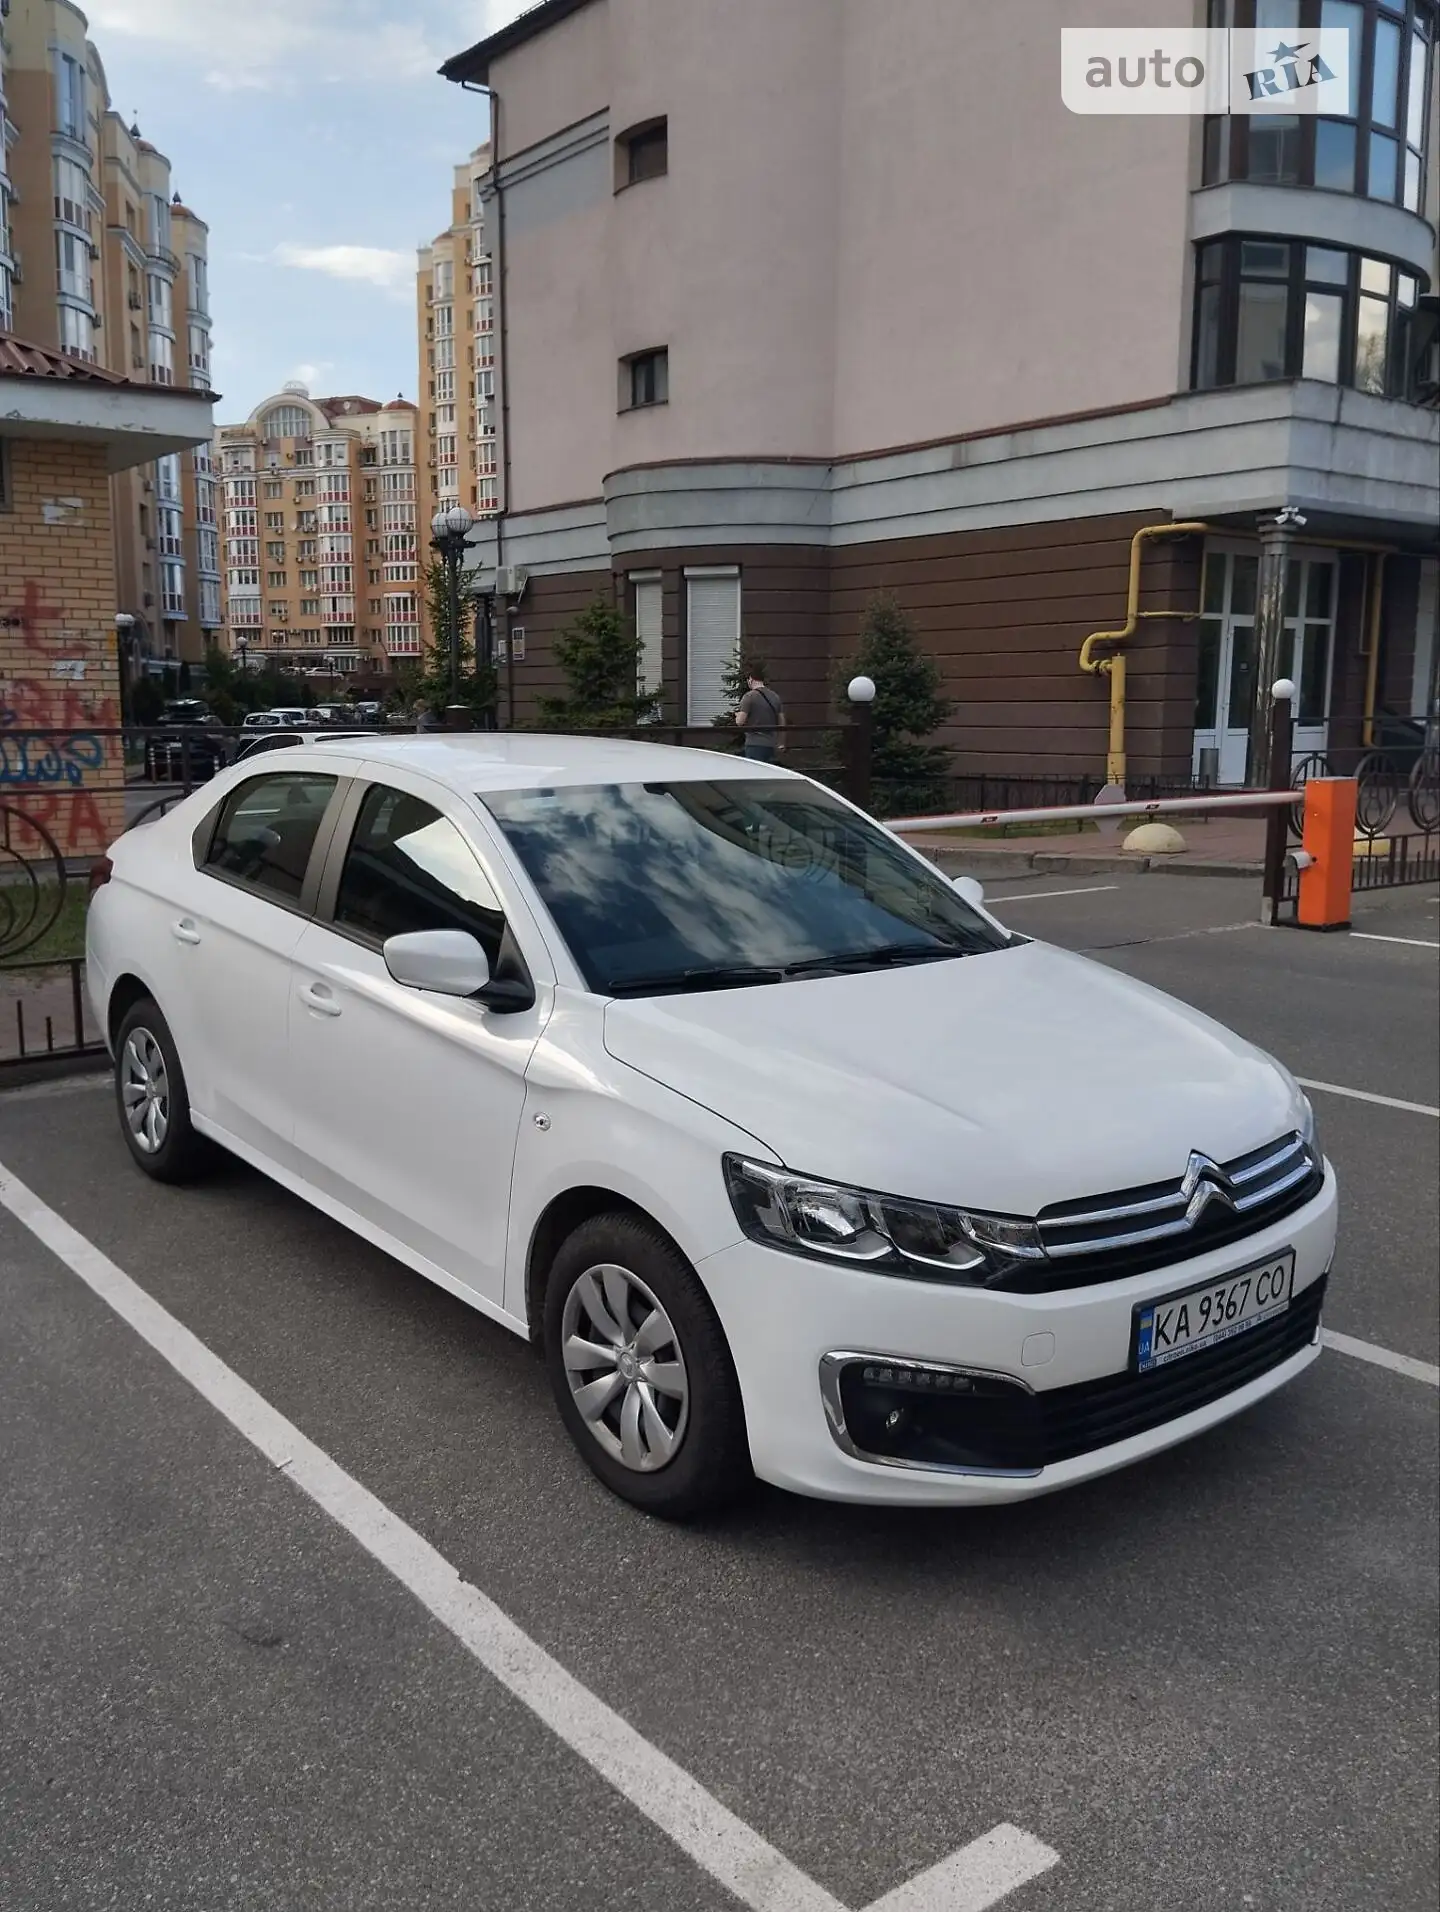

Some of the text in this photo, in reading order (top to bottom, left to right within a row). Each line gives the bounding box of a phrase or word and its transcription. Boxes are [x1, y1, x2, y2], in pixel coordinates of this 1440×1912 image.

[1154, 1264, 1285, 1350] KA 9367 CO
[1138, 1341, 1150, 1355] UA
